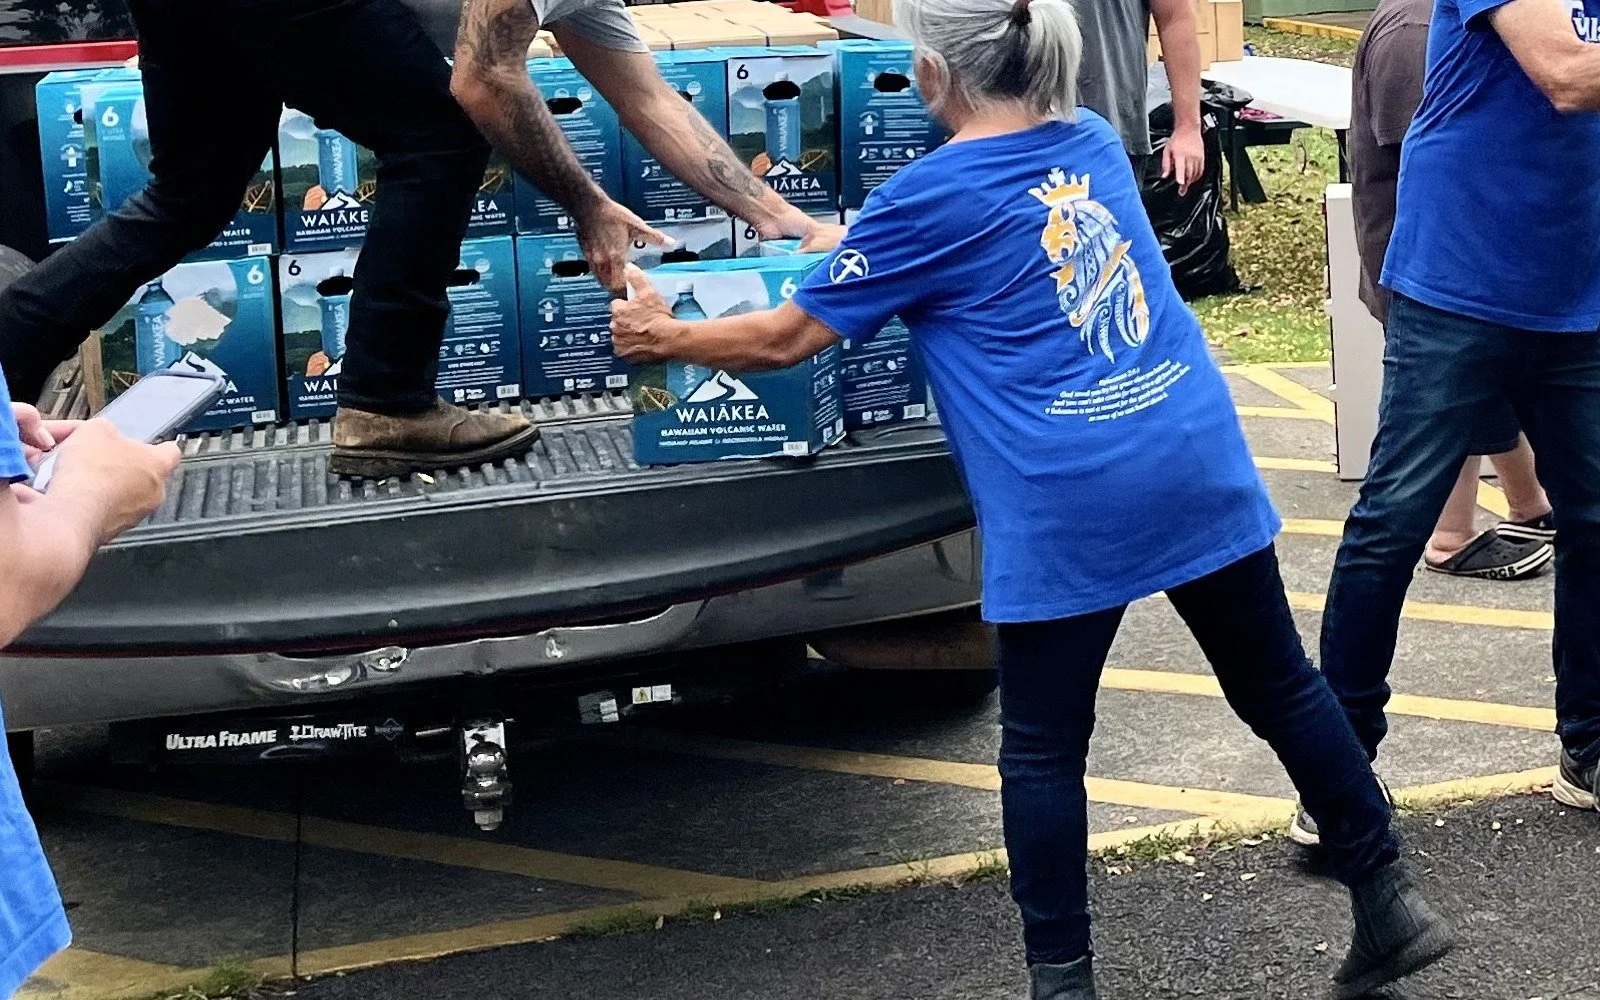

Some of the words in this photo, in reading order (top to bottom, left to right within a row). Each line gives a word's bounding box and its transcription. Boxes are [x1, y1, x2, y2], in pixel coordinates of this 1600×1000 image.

[736, 64, 749, 80] 6
[101, 105, 119, 127] 6
[773, 176, 821, 191] IĀKEA
[301, 209, 369, 227] WAIĀKE
[744, 225, 756, 240] 6
[246, 264, 264, 285] 6
[288, 260, 302, 276] 6
[780, 277, 797, 299] 6
[676, 403, 769, 423] WAIĀKEA
[660, 426, 708, 437] HAWAIIAN
[710, 424, 755, 435] VOLCANIC
[757, 423, 786, 432] WATER
[166, 733, 217, 751] ULTRA
[219, 730, 277, 747] FRAME
